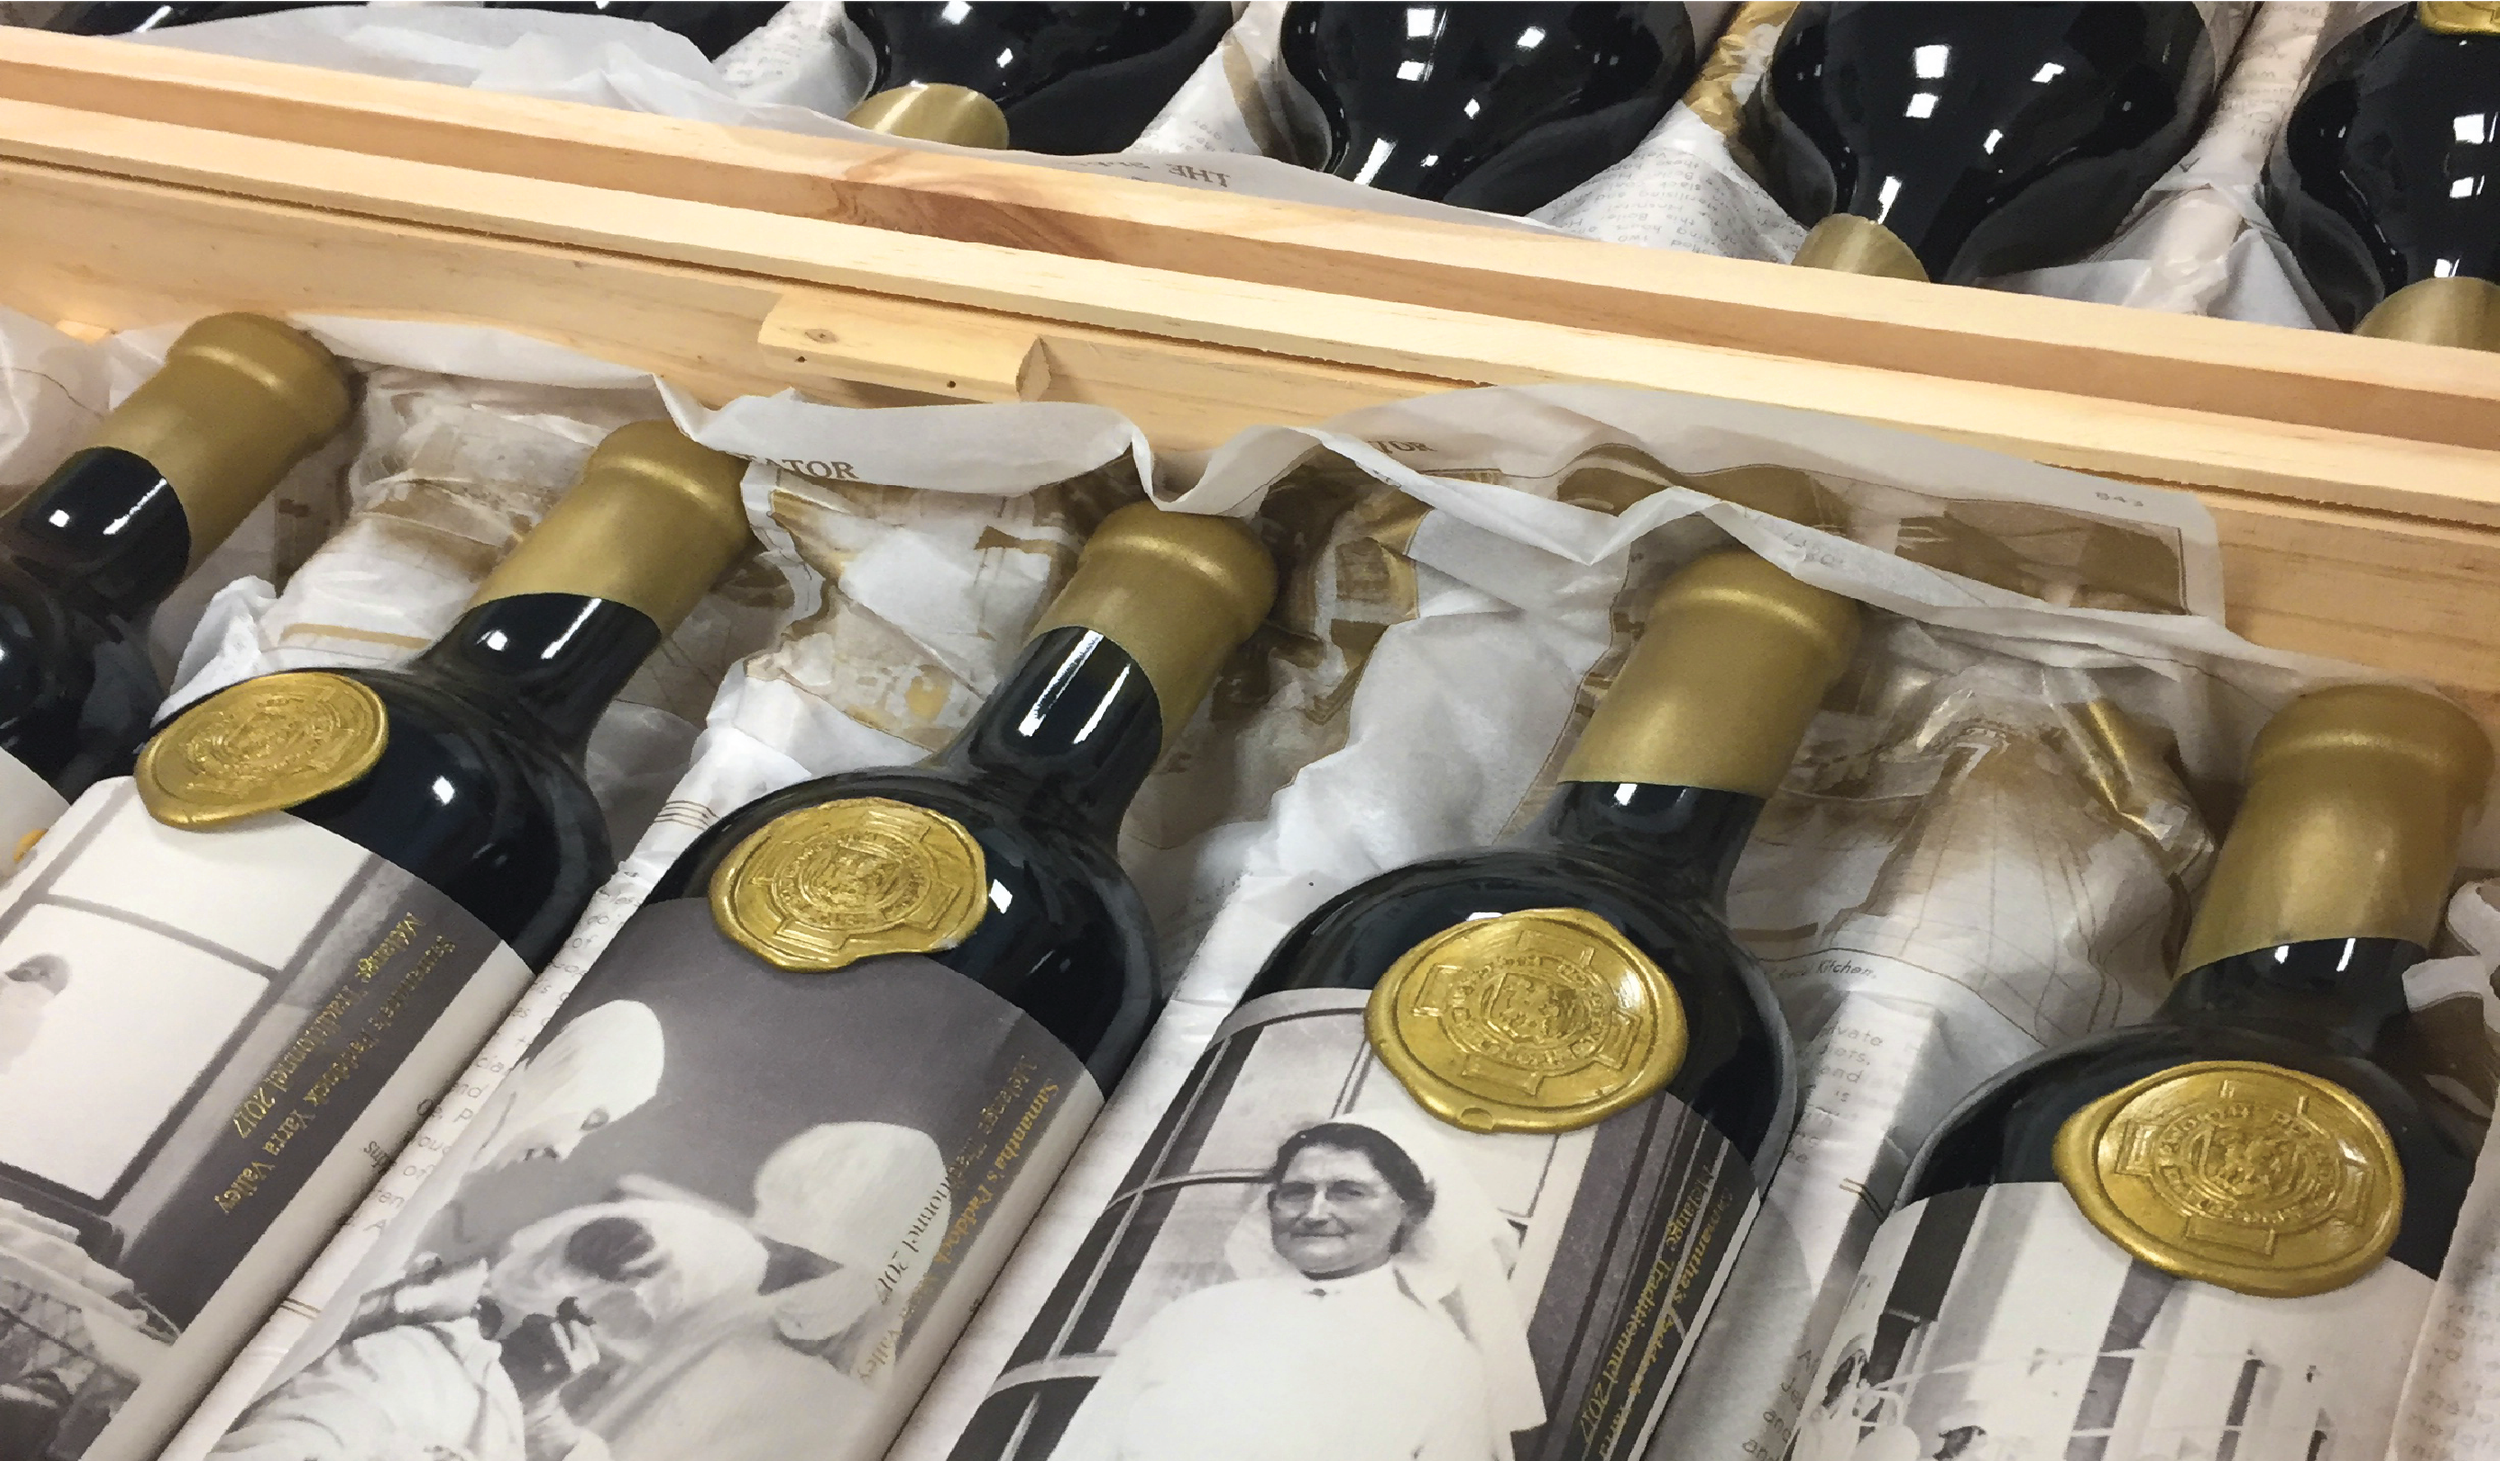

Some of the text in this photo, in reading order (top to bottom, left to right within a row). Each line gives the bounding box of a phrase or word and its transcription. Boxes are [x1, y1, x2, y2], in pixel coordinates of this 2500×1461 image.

[231, 1088, 276, 1140] 2017
[262, 1109, 315, 1157] Yarra
[987, 1083, 1060, 1181] Samantha's
[214, 1160, 277, 1214] Valley
